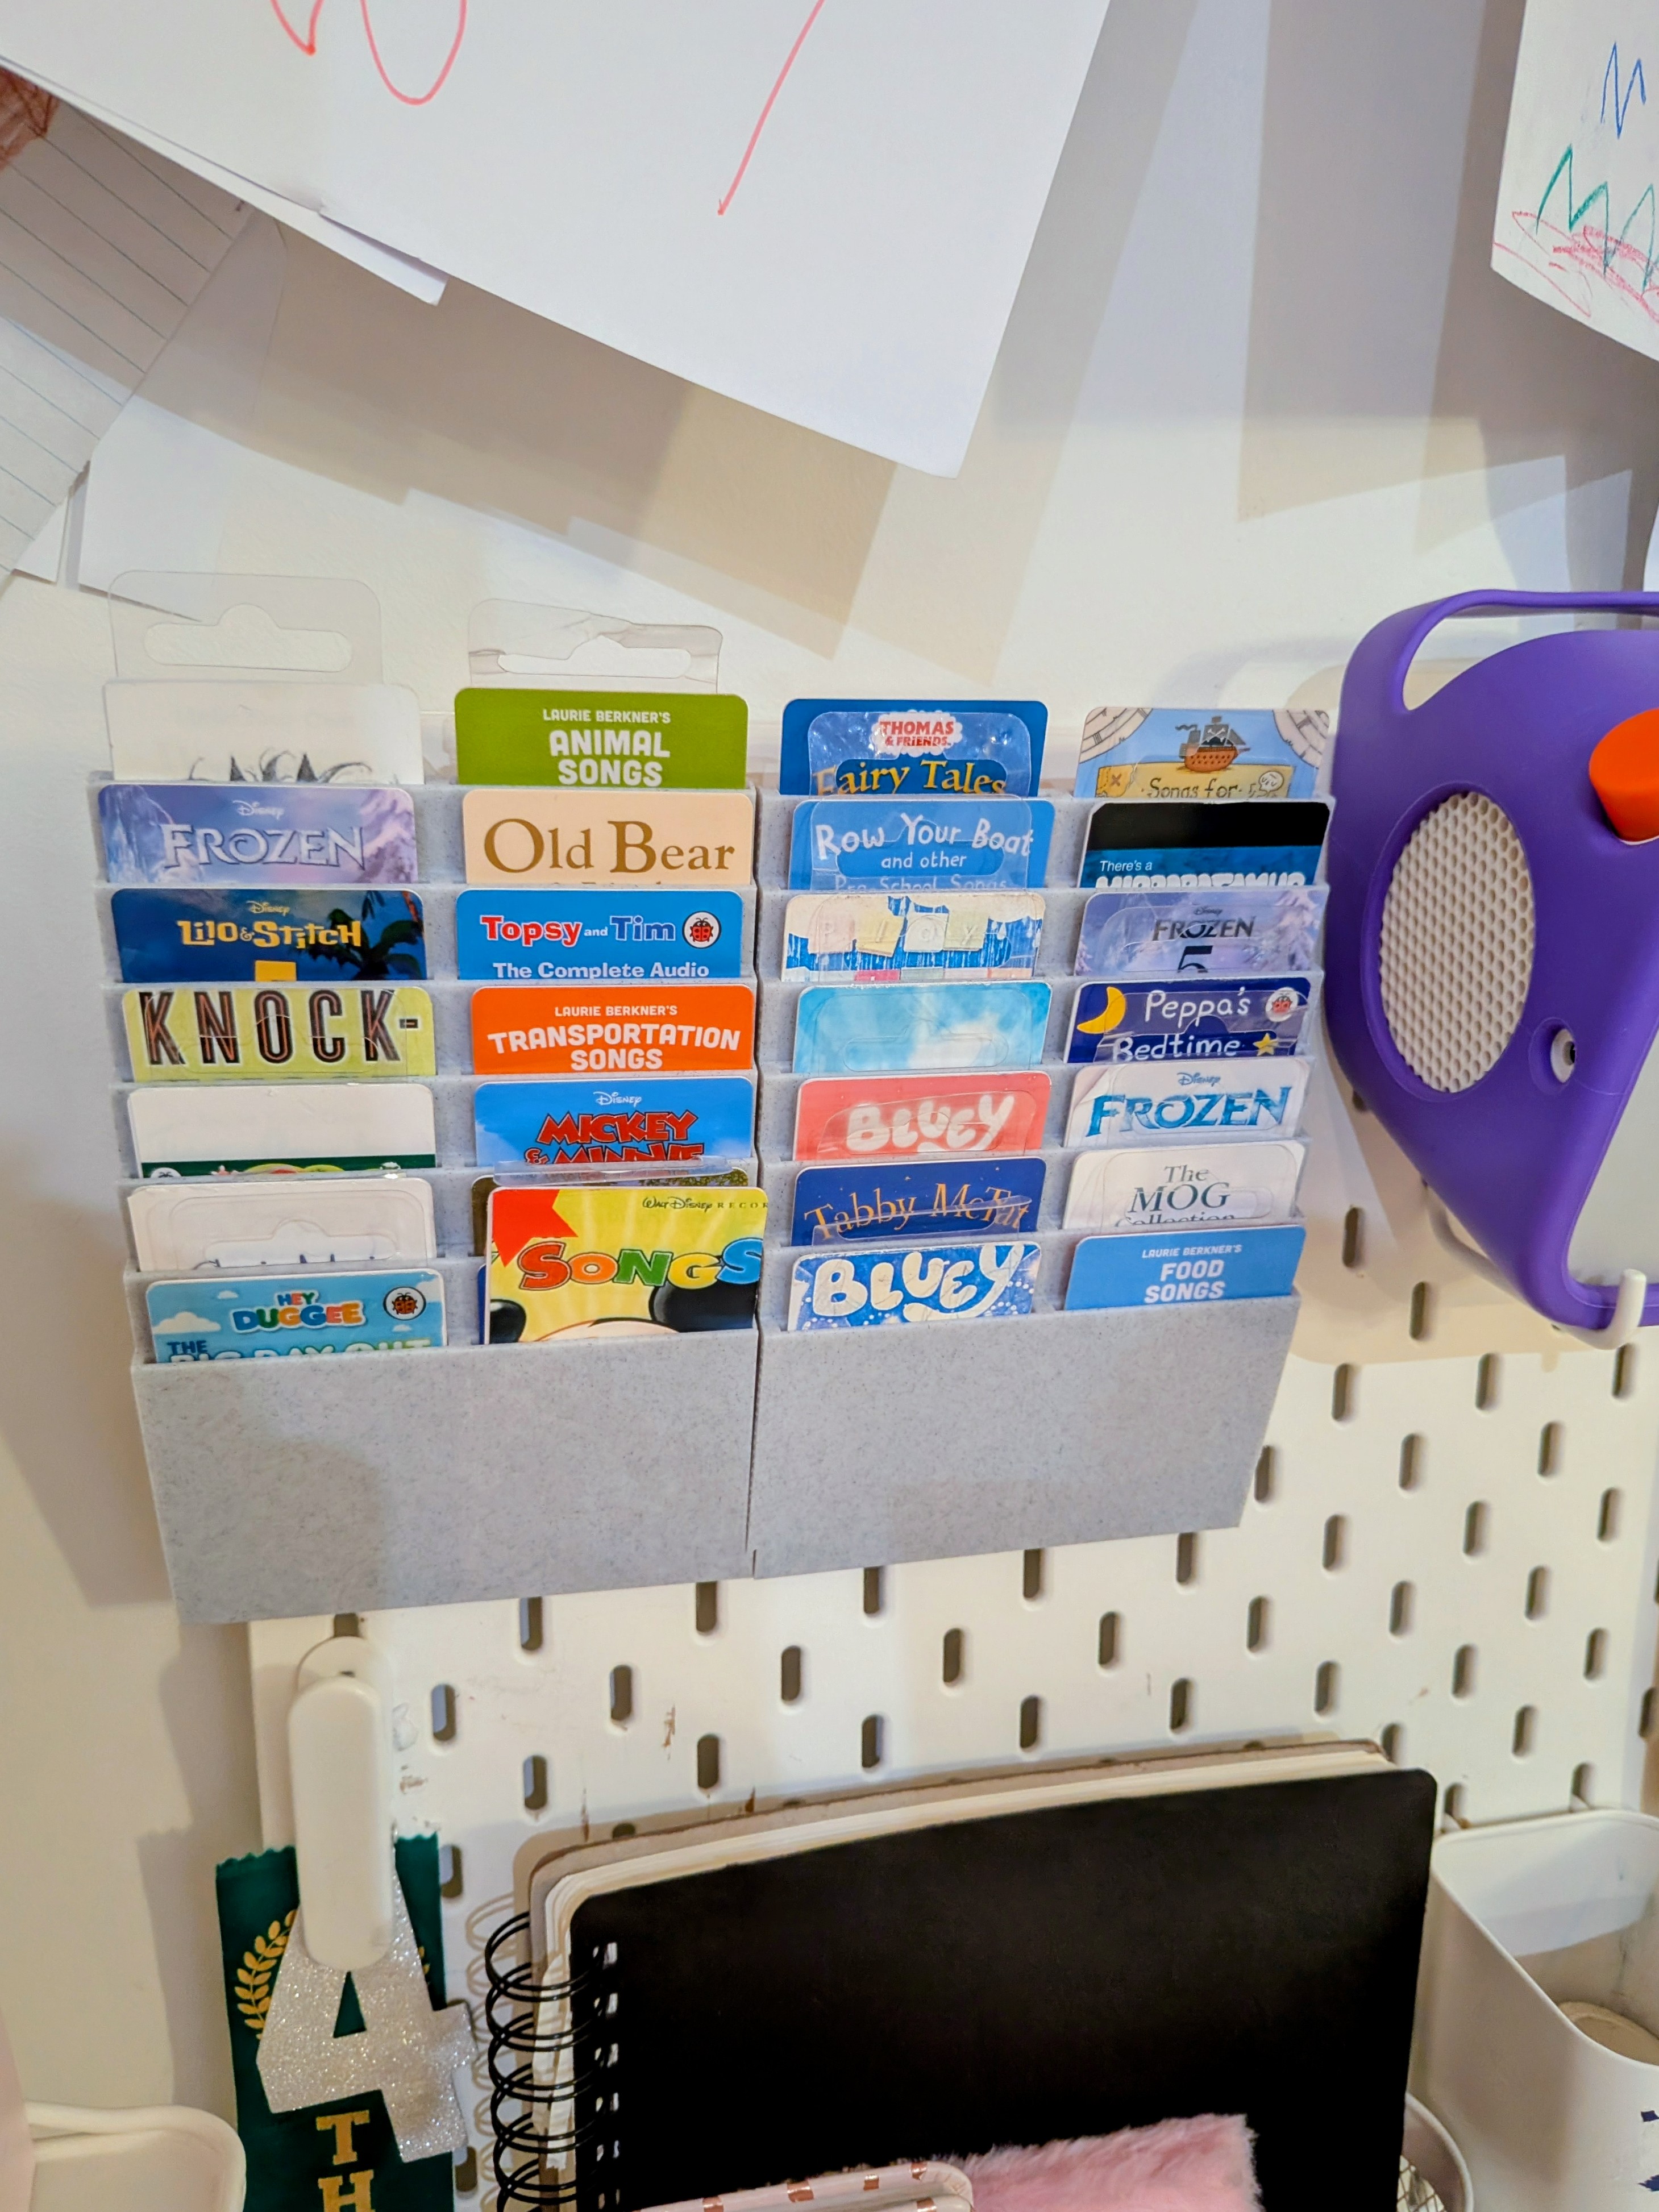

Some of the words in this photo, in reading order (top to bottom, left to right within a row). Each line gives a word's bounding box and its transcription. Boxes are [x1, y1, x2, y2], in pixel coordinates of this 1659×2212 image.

[543, 709, 591, 722] LAURIE
[596, 710, 671, 724] BERKNER'S
[880, 721, 954, 736] THOMAS
[549, 729, 670, 758] ANIMAL
[885, 736, 894, 746] &
[558, 759, 663, 787] SONGS
[812, 762, 910, 795] Fairy
[920, 759, 1007, 795] Tales
[1204, 778, 1238, 798] for
[159, 824, 366, 870] FROZEN
[484, 818, 594, 874] Old
[607, 821, 735, 874] Bear
[816, 824, 885, 860] Row
[901, 812, 962, 846] Your
[971, 818, 1034, 857] Boat
[881, 855, 913, 869] and
[920, 851, 967, 868] other
[1100, 860, 1142, 872] There's
[1145, 862, 1153, 871] a
[480, 914, 583, 948] Topsy
[584, 926, 608, 937] and
[609, 915, 676, 942] Tim
[1152, 916, 1257, 941] FROZEN
[493, 963, 532, 978] The
[538, 962, 645, 979] Complete
[650, 962, 709, 978] Audio
[555, 1006, 601, 1017] LAURIE
[605, 1005, 677, 1016] BERKNER'S
[1145, 986, 1250, 1028] Peppa's
[139, 989, 419, 1066] KNOCK-
[488, 1024, 741, 1054] TRANSPORTATION
[570, 1047, 663, 1071] SONGS
[1112, 1034, 1241, 1062] Bedtime
[846, 1093, 1014, 1153] BLUEY
[1086, 1086, 1292, 1137] FROZEN
[535, 1109, 698, 1146] MICKEY
[1165, 1165, 1209, 1183] The
[1128, 1182, 1230, 1213] MOG
[804, 1187, 917, 1240] Tabby
[518, 1237, 763, 1292] SONGS
[1142, 1248, 1179, 1258] LAURIE
[1183, 1244, 1242, 1256] BERKNER'S
[812, 1243, 1025, 1323] BLUEY
[1160, 1259, 1224, 1282] FOOD
[276, 1292, 316, 1307] HEY
[1144, 1282, 1225, 1304] SONGS
[231, 1302, 365, 1333] DUGGEE
[167, 1340, 208, 1356] THE
